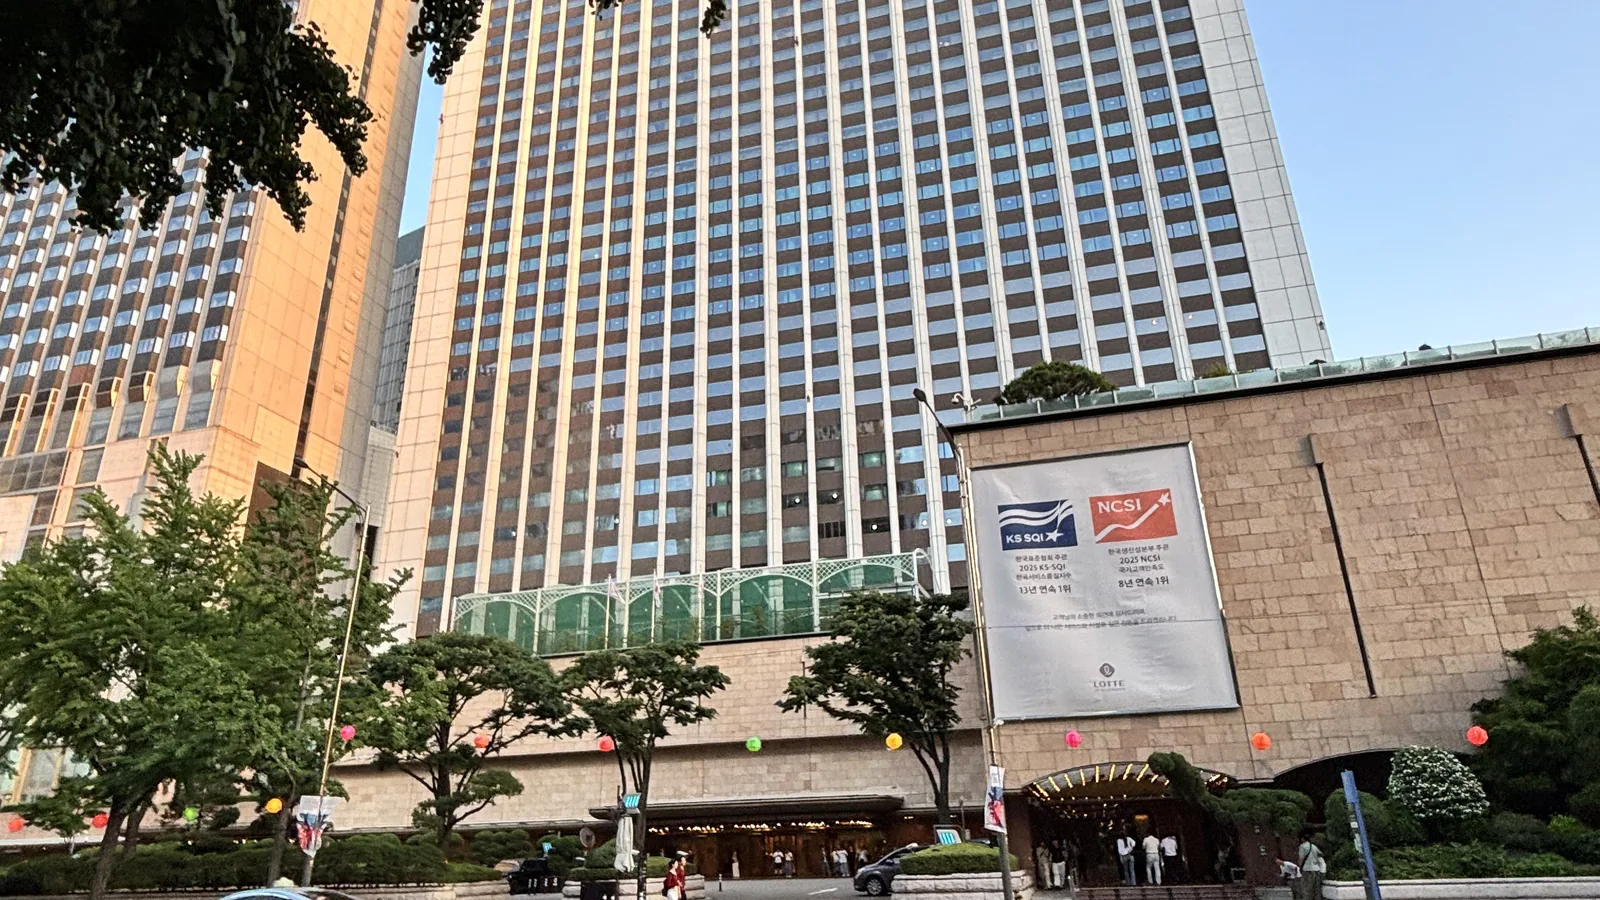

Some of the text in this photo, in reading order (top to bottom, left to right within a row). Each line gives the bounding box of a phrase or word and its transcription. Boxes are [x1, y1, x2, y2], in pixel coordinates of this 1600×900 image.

[1097, 498, 1142, 514] NCSI
[1006, 533, 1044, 544] KS SQI
[1108, 543, 1169, 555] 한국생산성본부 주관
[1054, 553, 1068, 561] 주관
[1119, 554, 1161, 564] 2025 NCSI
[1019, 564, 1038, 572] 2025
[1118, 576, 1169, 588] 8년 연속 1위
[1019, 584, 1072, 594] 13년 연속 1위
[1093, 679, 1125, 688] LOTTE
